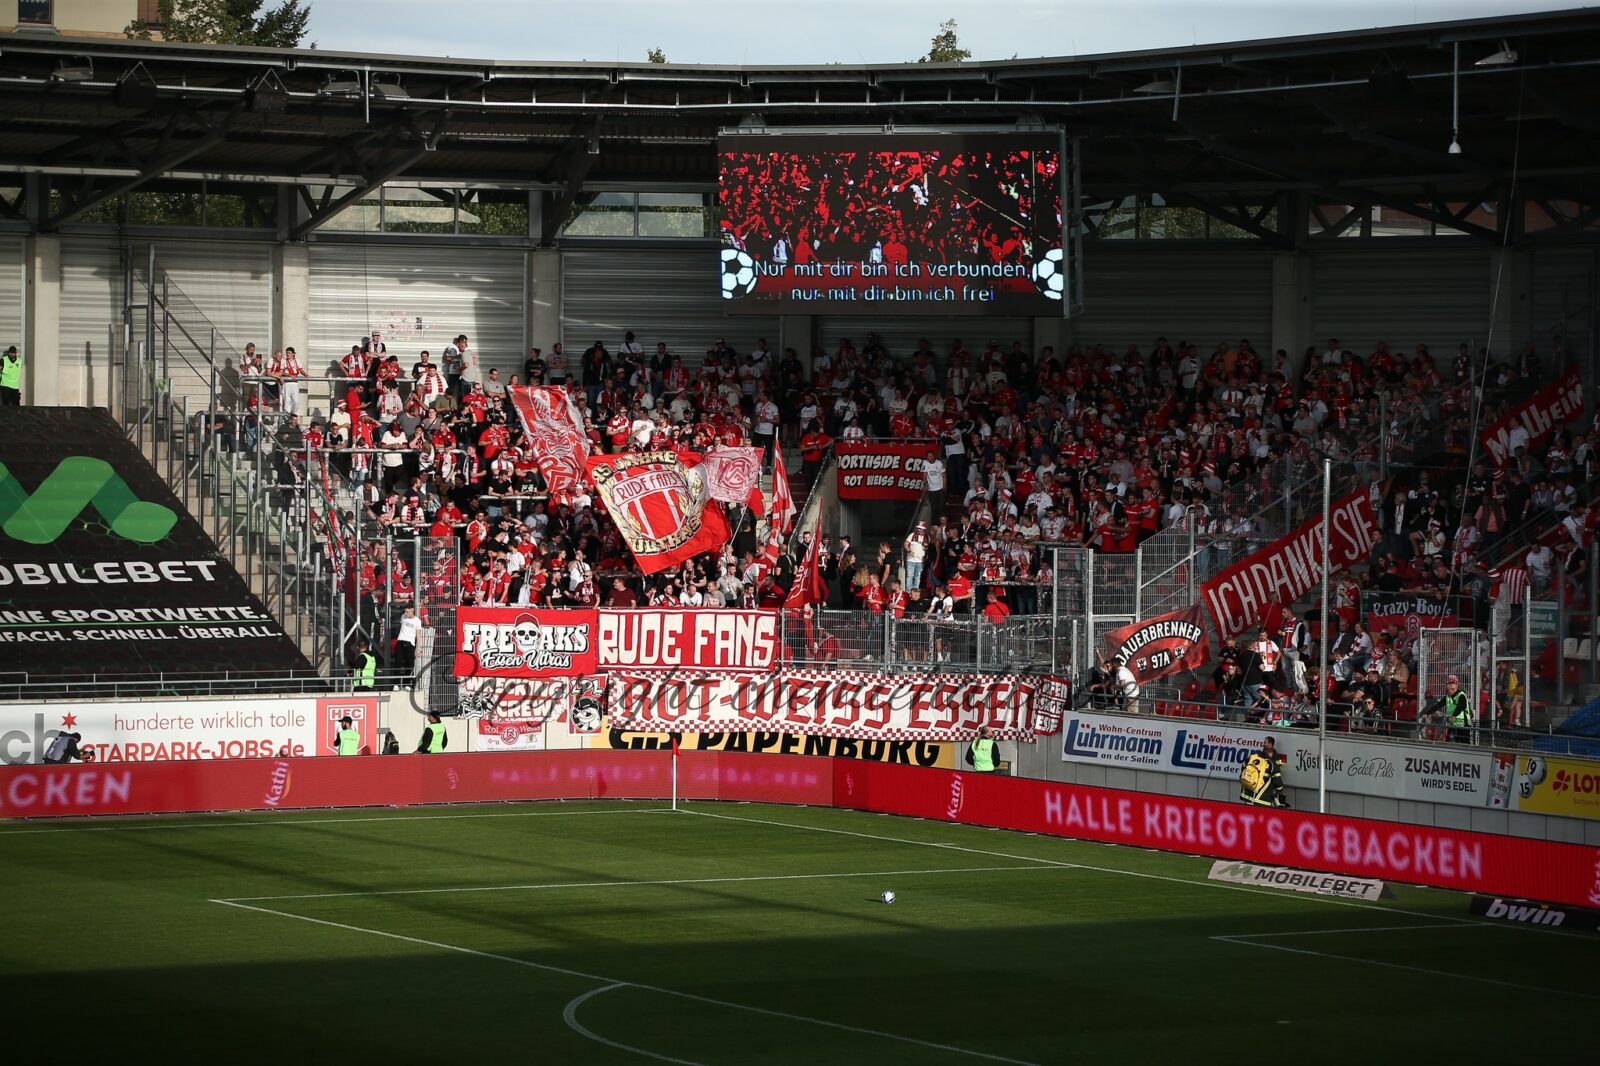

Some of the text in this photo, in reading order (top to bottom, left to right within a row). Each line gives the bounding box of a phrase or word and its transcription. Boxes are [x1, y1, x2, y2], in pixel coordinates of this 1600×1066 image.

[755, 260, 1031, 279] Nur mit dir bin ich verbunden,
[791, 285, 994, 301] nur mit dir bin ich frei
[616, 473, 680, 501] RUDE FANS
[843, 475, 864, 486] ROT
[866, 475, 895, 487] WEISS
[51, 606, 268, 623] SPORTWETTE.
[72, 627, 179, 640] SCHNELL.
[178, 625, 283, 639] ÜBERALL.
[462, 623, 589, 654] FREAKS
[598, 613, 776, 668] RUDE FANS
[479, 649, 572, 670] Essen Ultras
[1151, 651, 1171, 669] 97A
[906, 683, 1037, 732] ESSEN
[114, 709, 306, 731] hunderte wirklich tolle
[1098, 723, 1163, 738] Wohn-Centrum
[1064, 719, 1163, 758] Lührmann
[1207, 734, 1265, 748] Wohn-Centru
[1113, 752, 1128, 762] der
[1130, 753, 1160, 766] Saline
[1223, 764, 1240, 774] der
[1347, 757, 1395, 779] Edel Pils
[1405, 757, 1481, 779] ZUSAMMEN
[264, 760, 290, 806] Kathi
[1420, 778, 1452, 790] WIRD'S
[1453, 782, 1477, 793] EDEL.
[1520, 781, 1531, 795] 15
[947, 773, 962, 819] Kathi
[1043, 788, 1483, 881] HALLE KRIEGT'S GEBACKEN
[1254, 868, 1377, 895] MOBILEBET
[1485, 898, 1566, 926] bwin
